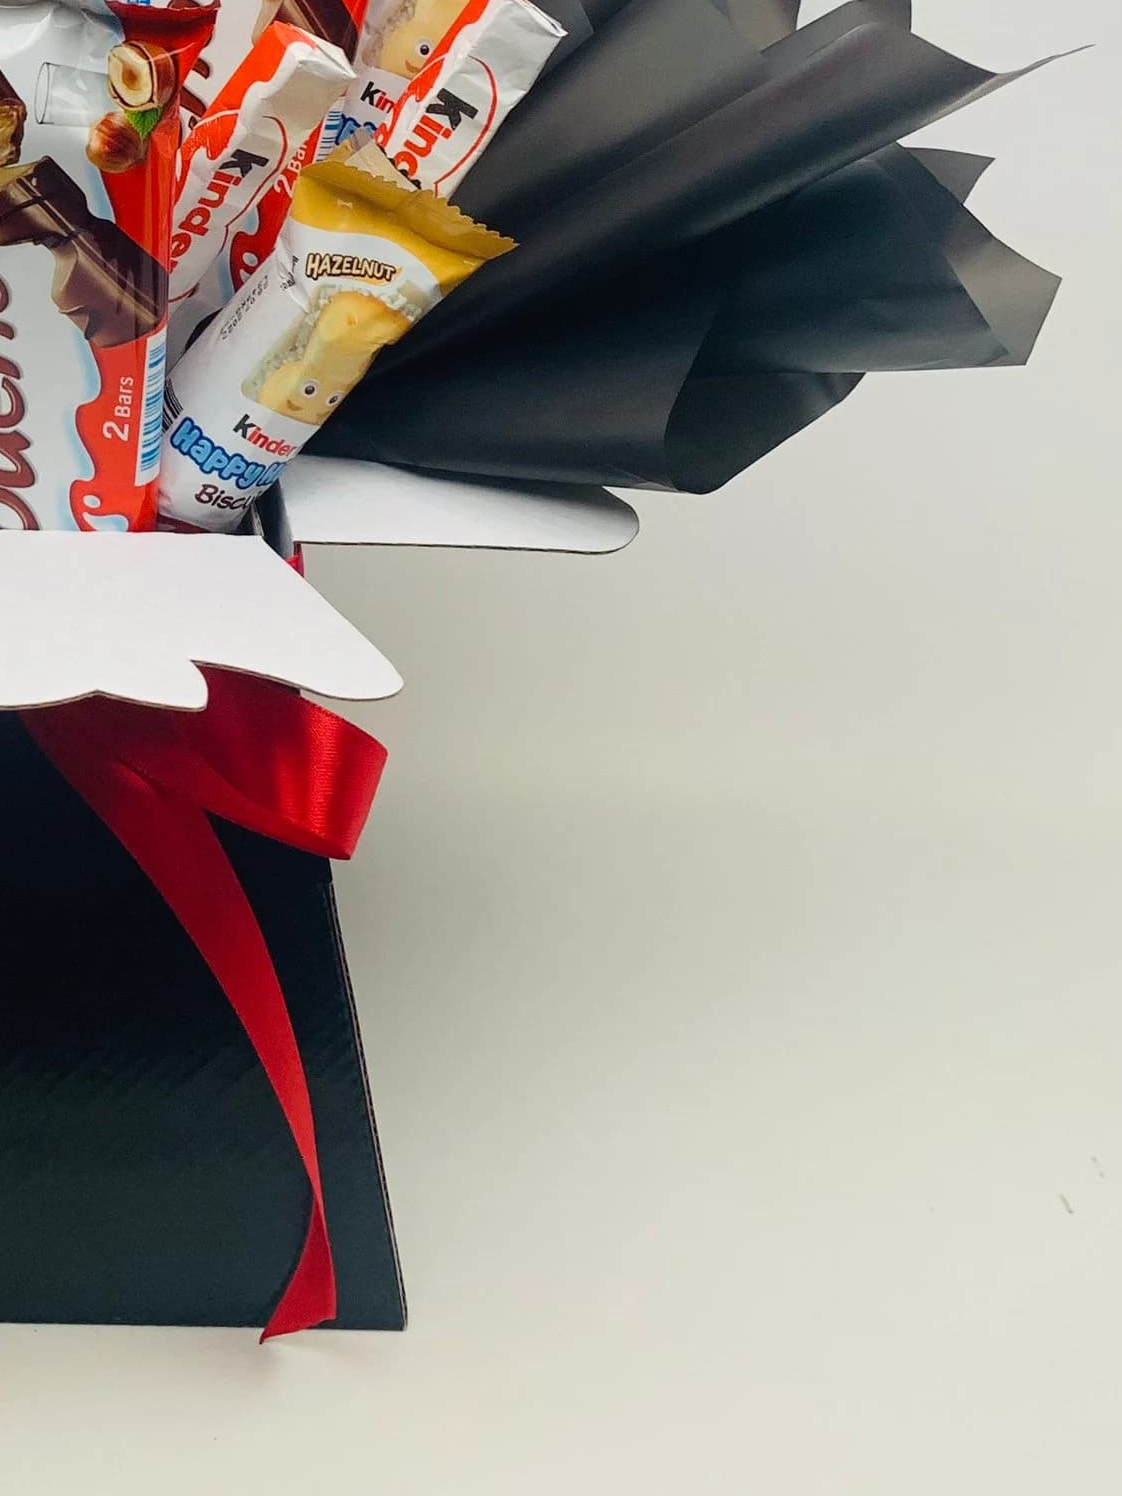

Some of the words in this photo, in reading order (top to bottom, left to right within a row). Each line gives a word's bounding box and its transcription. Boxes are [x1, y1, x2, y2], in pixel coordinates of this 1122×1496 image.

[306, 252, 397, 282] HAZELNUT
[114, 376, 134, 418] Bars
[102, 420, 130, 442] 2
[169, 416, 266, 490] Happy
